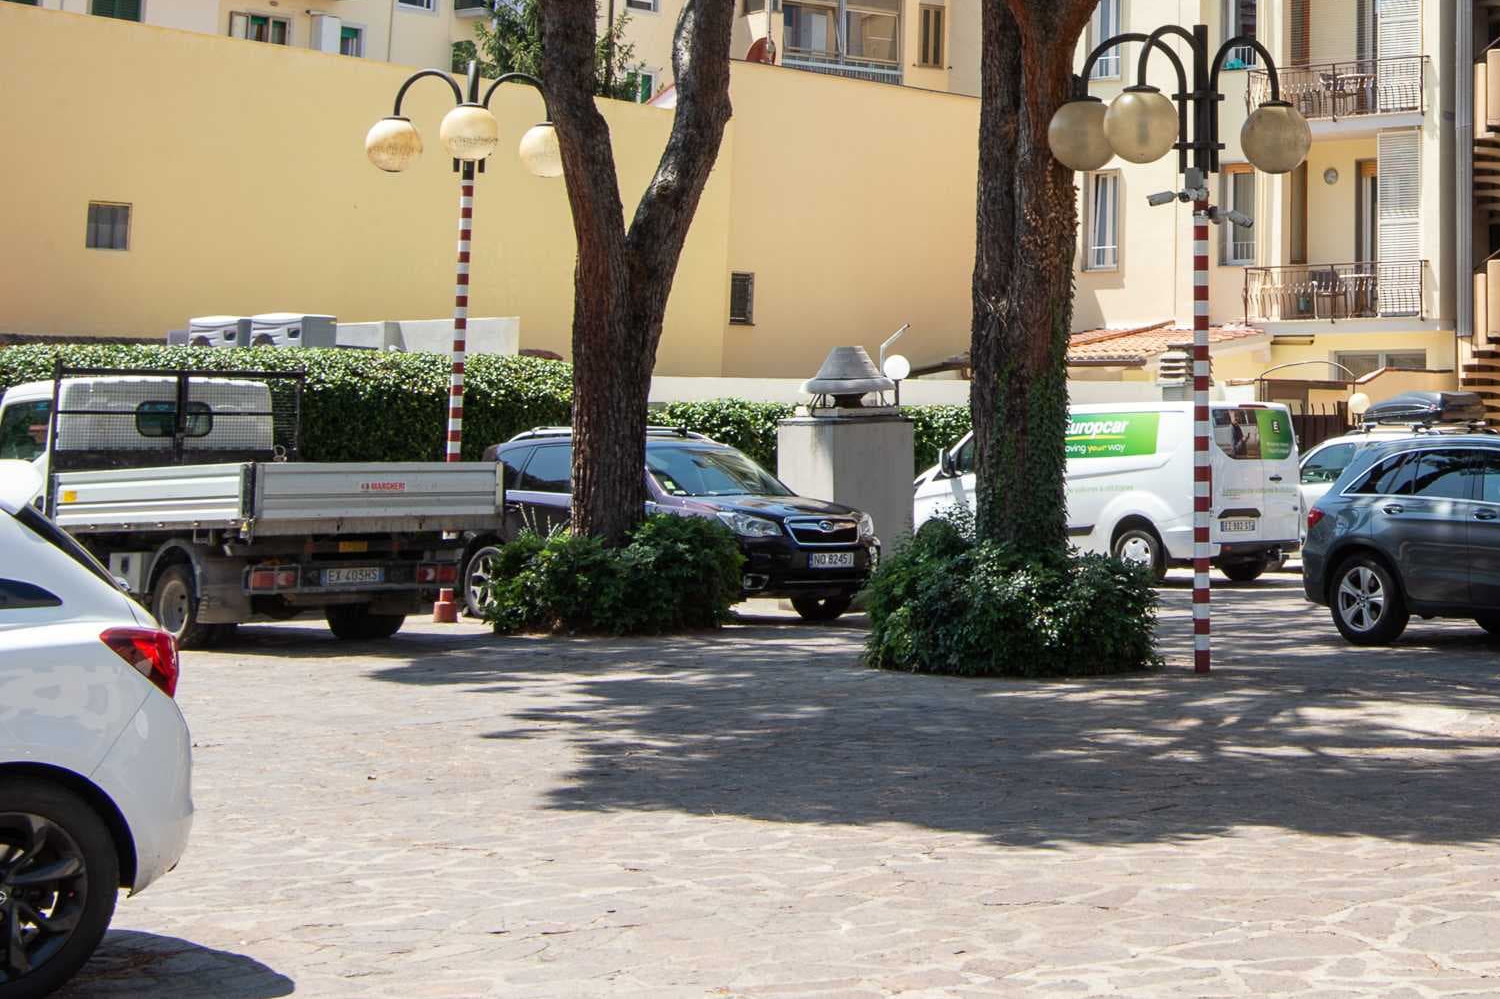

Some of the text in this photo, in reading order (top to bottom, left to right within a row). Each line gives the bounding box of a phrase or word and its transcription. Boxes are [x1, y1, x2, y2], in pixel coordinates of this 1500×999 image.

[1065, 443, 1126, 454] oving your way
